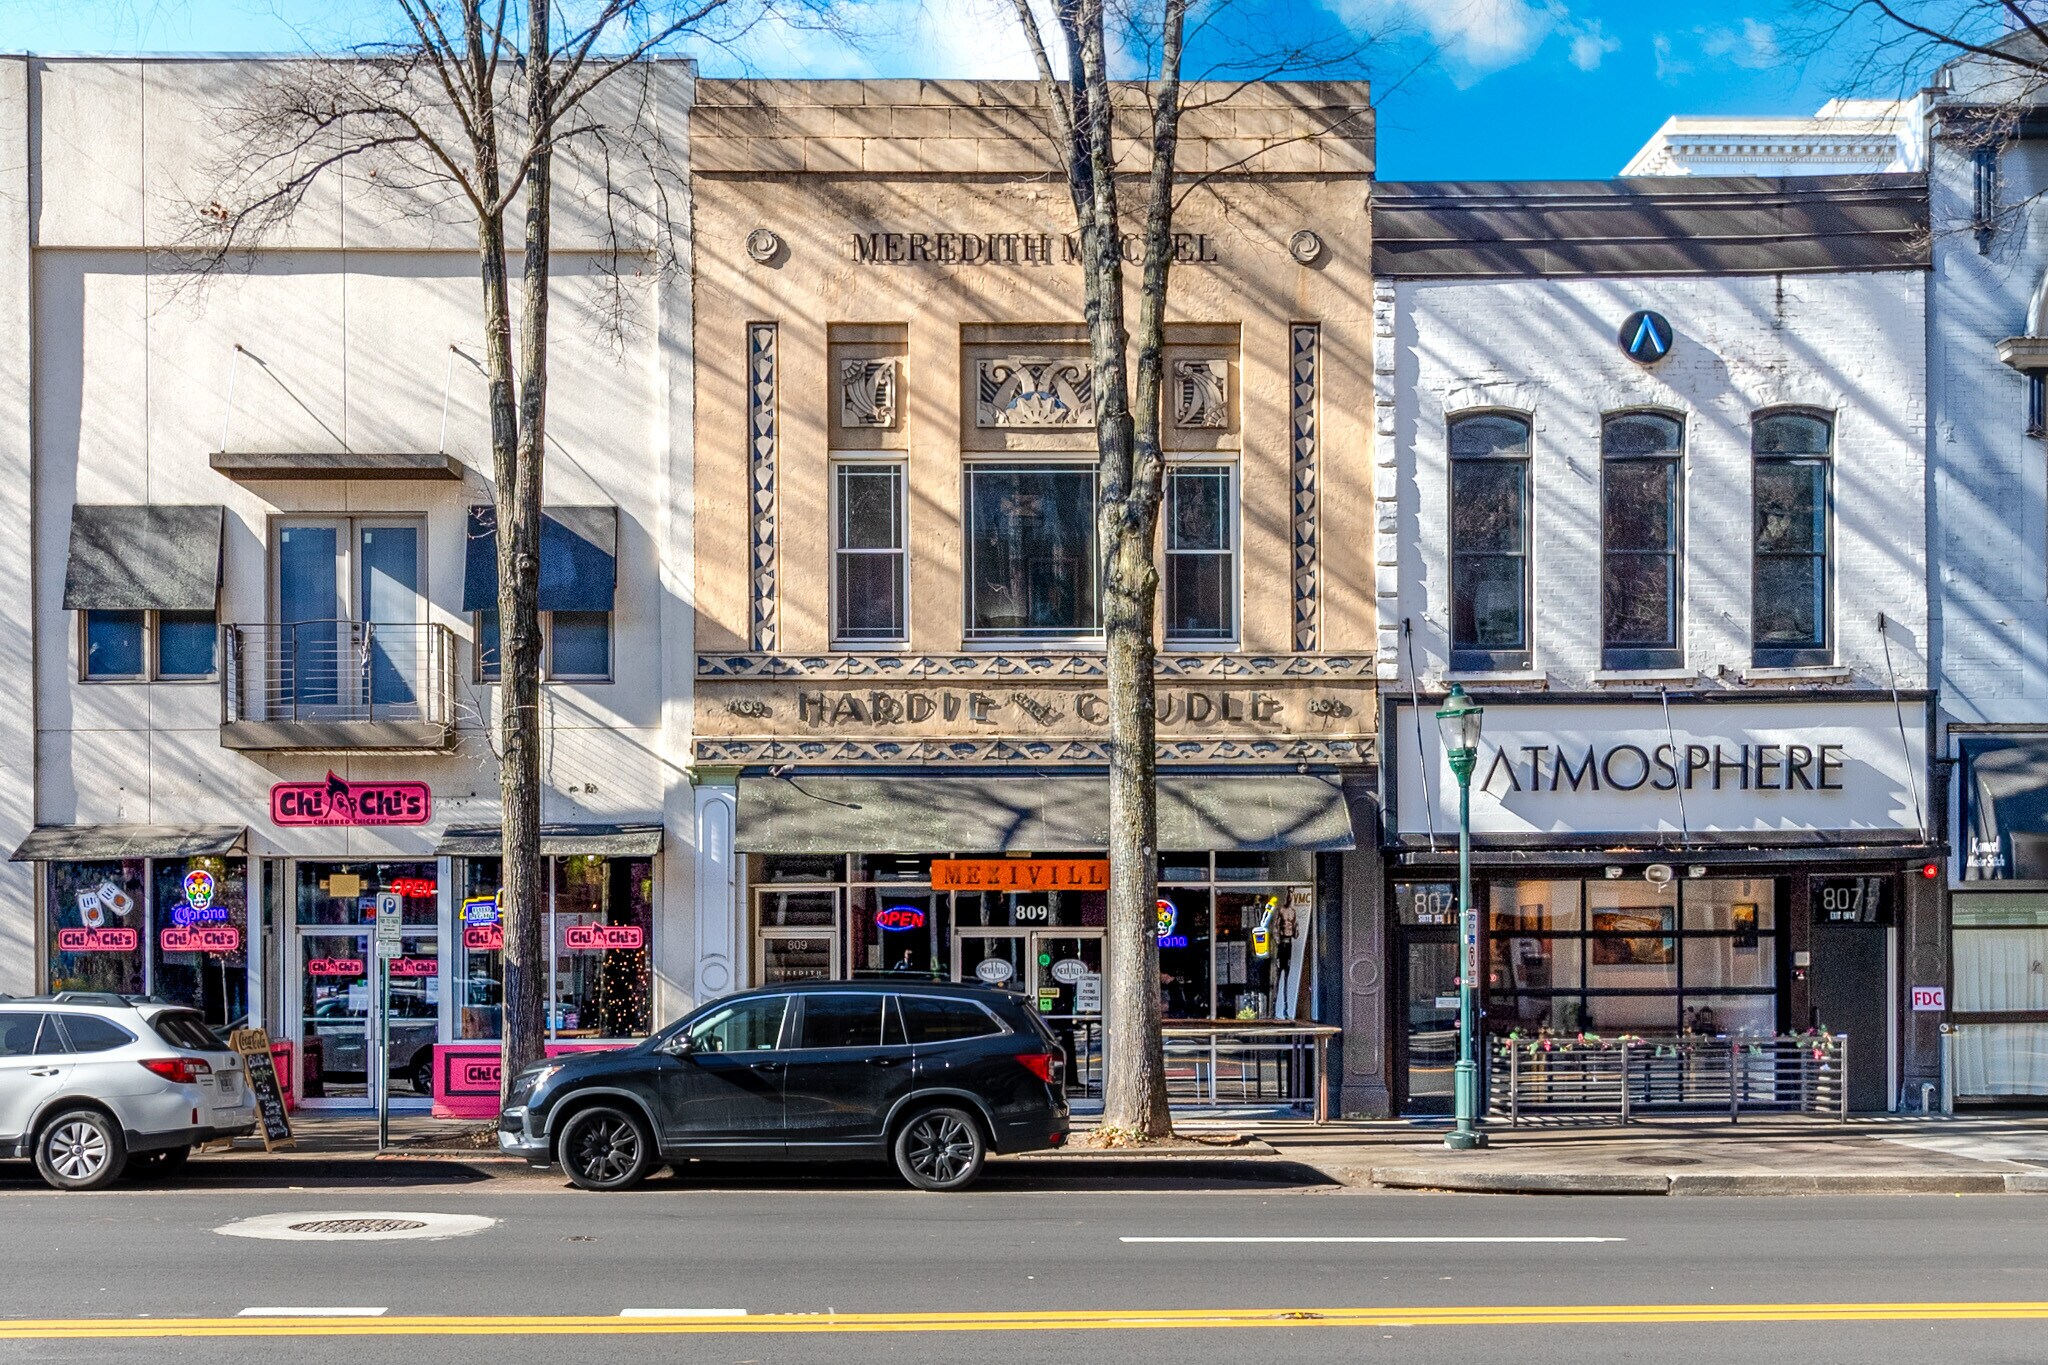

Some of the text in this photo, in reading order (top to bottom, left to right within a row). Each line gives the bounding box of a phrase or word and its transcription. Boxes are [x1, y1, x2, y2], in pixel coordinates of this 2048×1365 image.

[850, 232, 1217, 262] MEREDITH MCEL
[800, 692, 990, 722] HARDIE
[1074, 692, 1275, 722] CUDLE
[1480, 743, 1843, 792] ATMOSPHERE
[280, 790, 421, 817] Chi Chi's
[944, 865, 1103, 885] MEXIVILL
[391, 879, 436, 897] OPEN
[1415, 893, 1453, 914] 807
[1823, 888, 1861, 910] 807
[173, 907, 227, 925] Corona
[876, 910, 925, 928] OPEN
[1016, 905, 1048, 920] 809
[64, 932, 132, 945] Chi Chi's
[166, 932, 234, 945] Chi Chi's
[468, 932, 488, 944] Chi
[570, 931, 637, 944] Chi Chi's
[787, 940, 807, 950] 809
[1158, 936, 1187, 947] rona
[312, 963, 359, 972] Chi Chi's
[390, 963, 437, 972] Chi Chi's
[1914, 991, 1942, 1006] FDC
[468, 1067, 491, 1081] Chi
